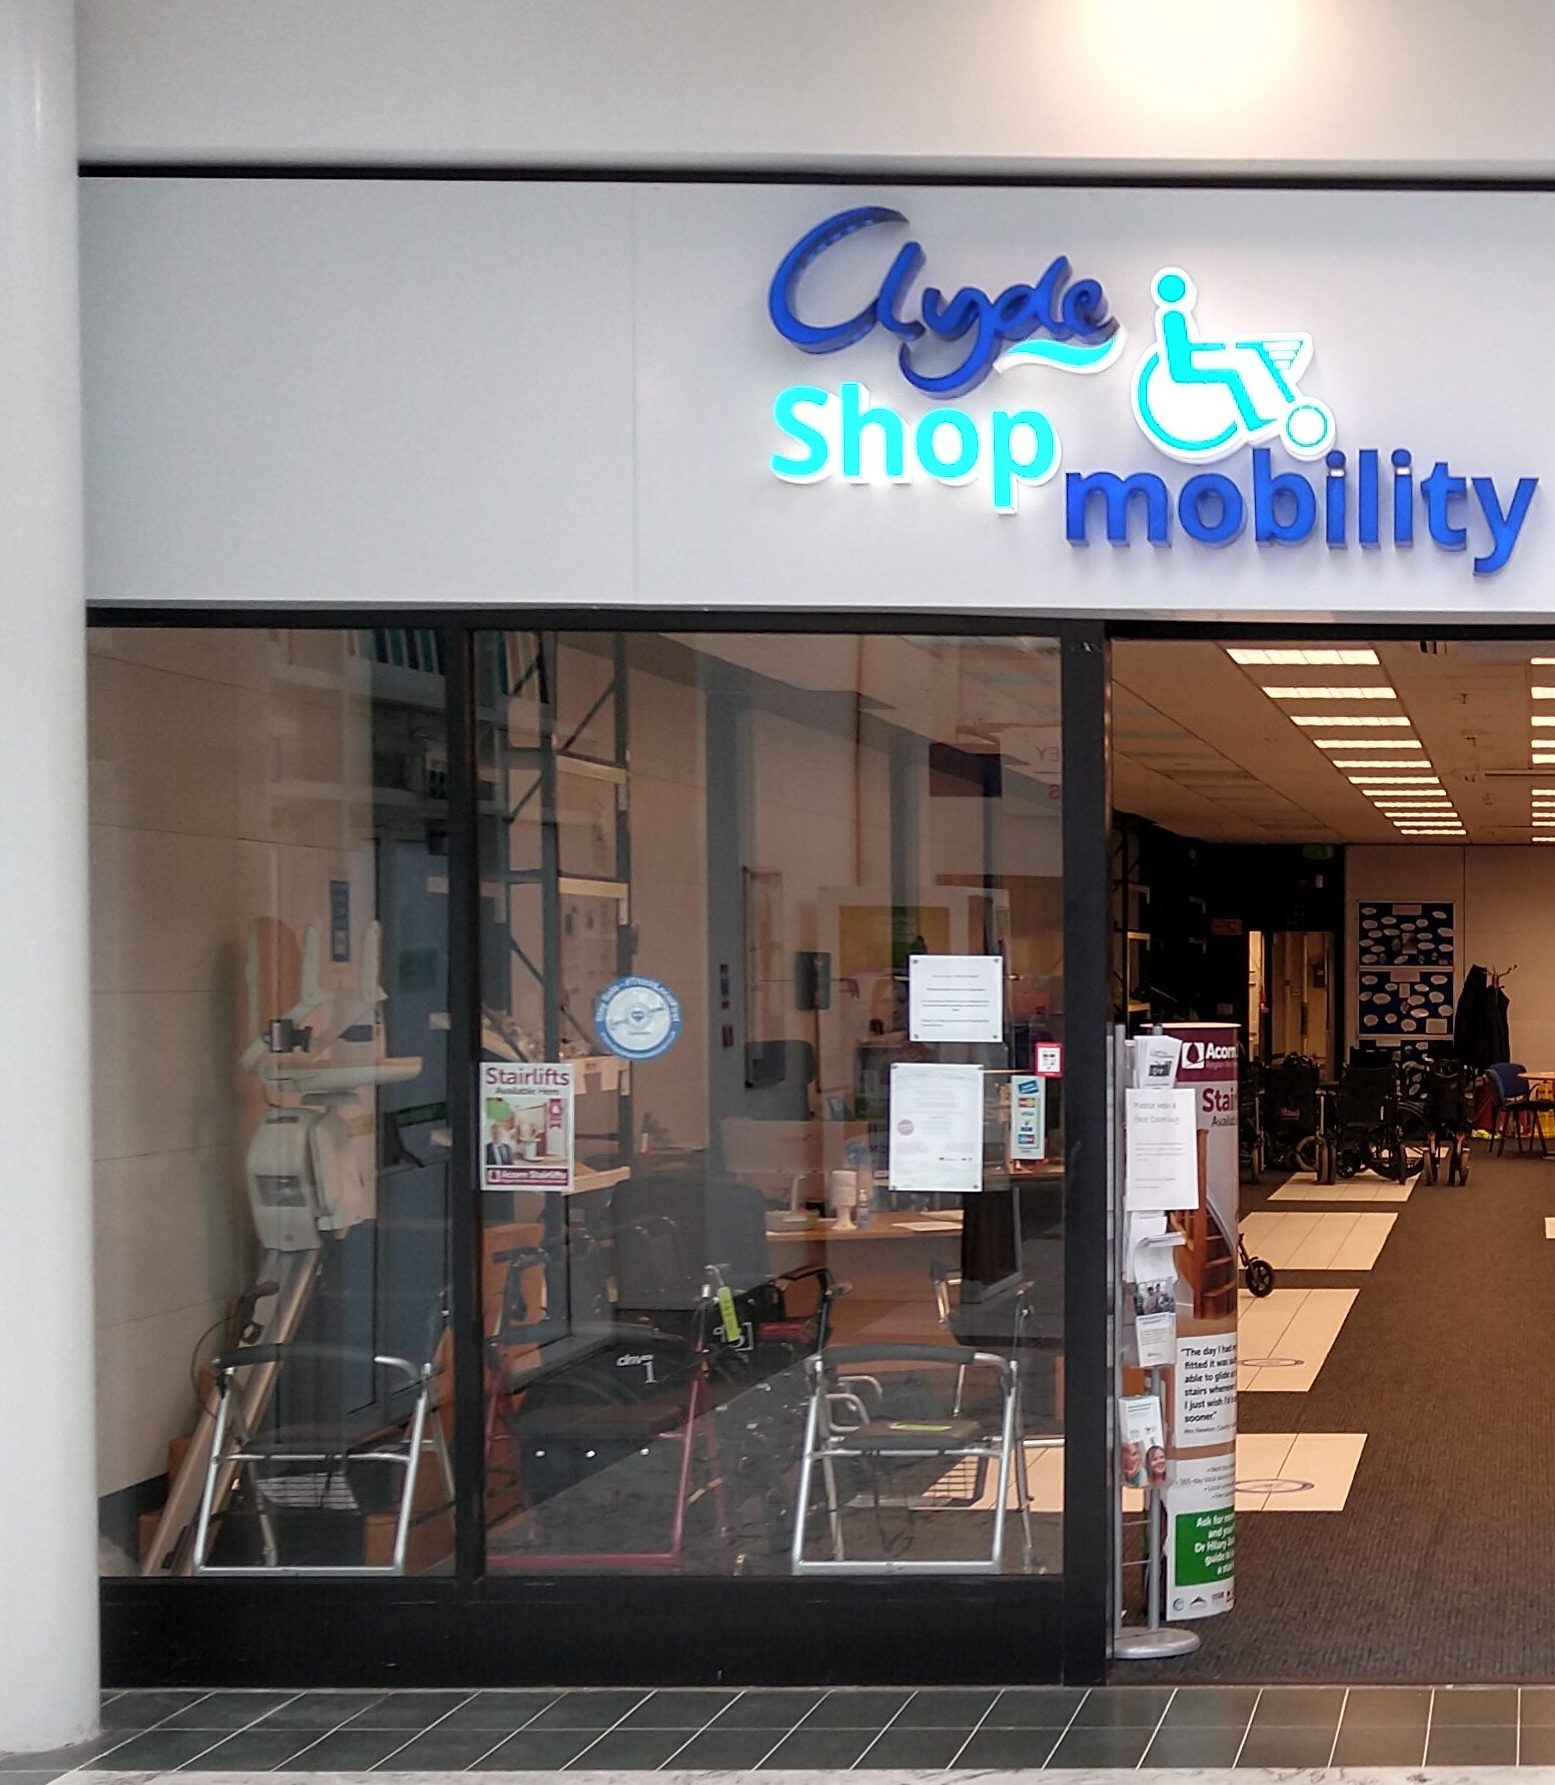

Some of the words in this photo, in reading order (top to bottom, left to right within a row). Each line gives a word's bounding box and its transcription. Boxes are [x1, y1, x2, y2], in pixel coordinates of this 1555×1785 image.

[768, 205, 1120, 397] Clyde
[770, 382, 1058, 513] Shop
[1065, 448, 1540, 577] mobility
[485, 1066, 570, 1087] Stairlifts
[1202, 1087, 1237, 1113] Stai
[1196, 1515, 1212, 1528] Ask
[1194, 1542, 1206, 1554] Dr
